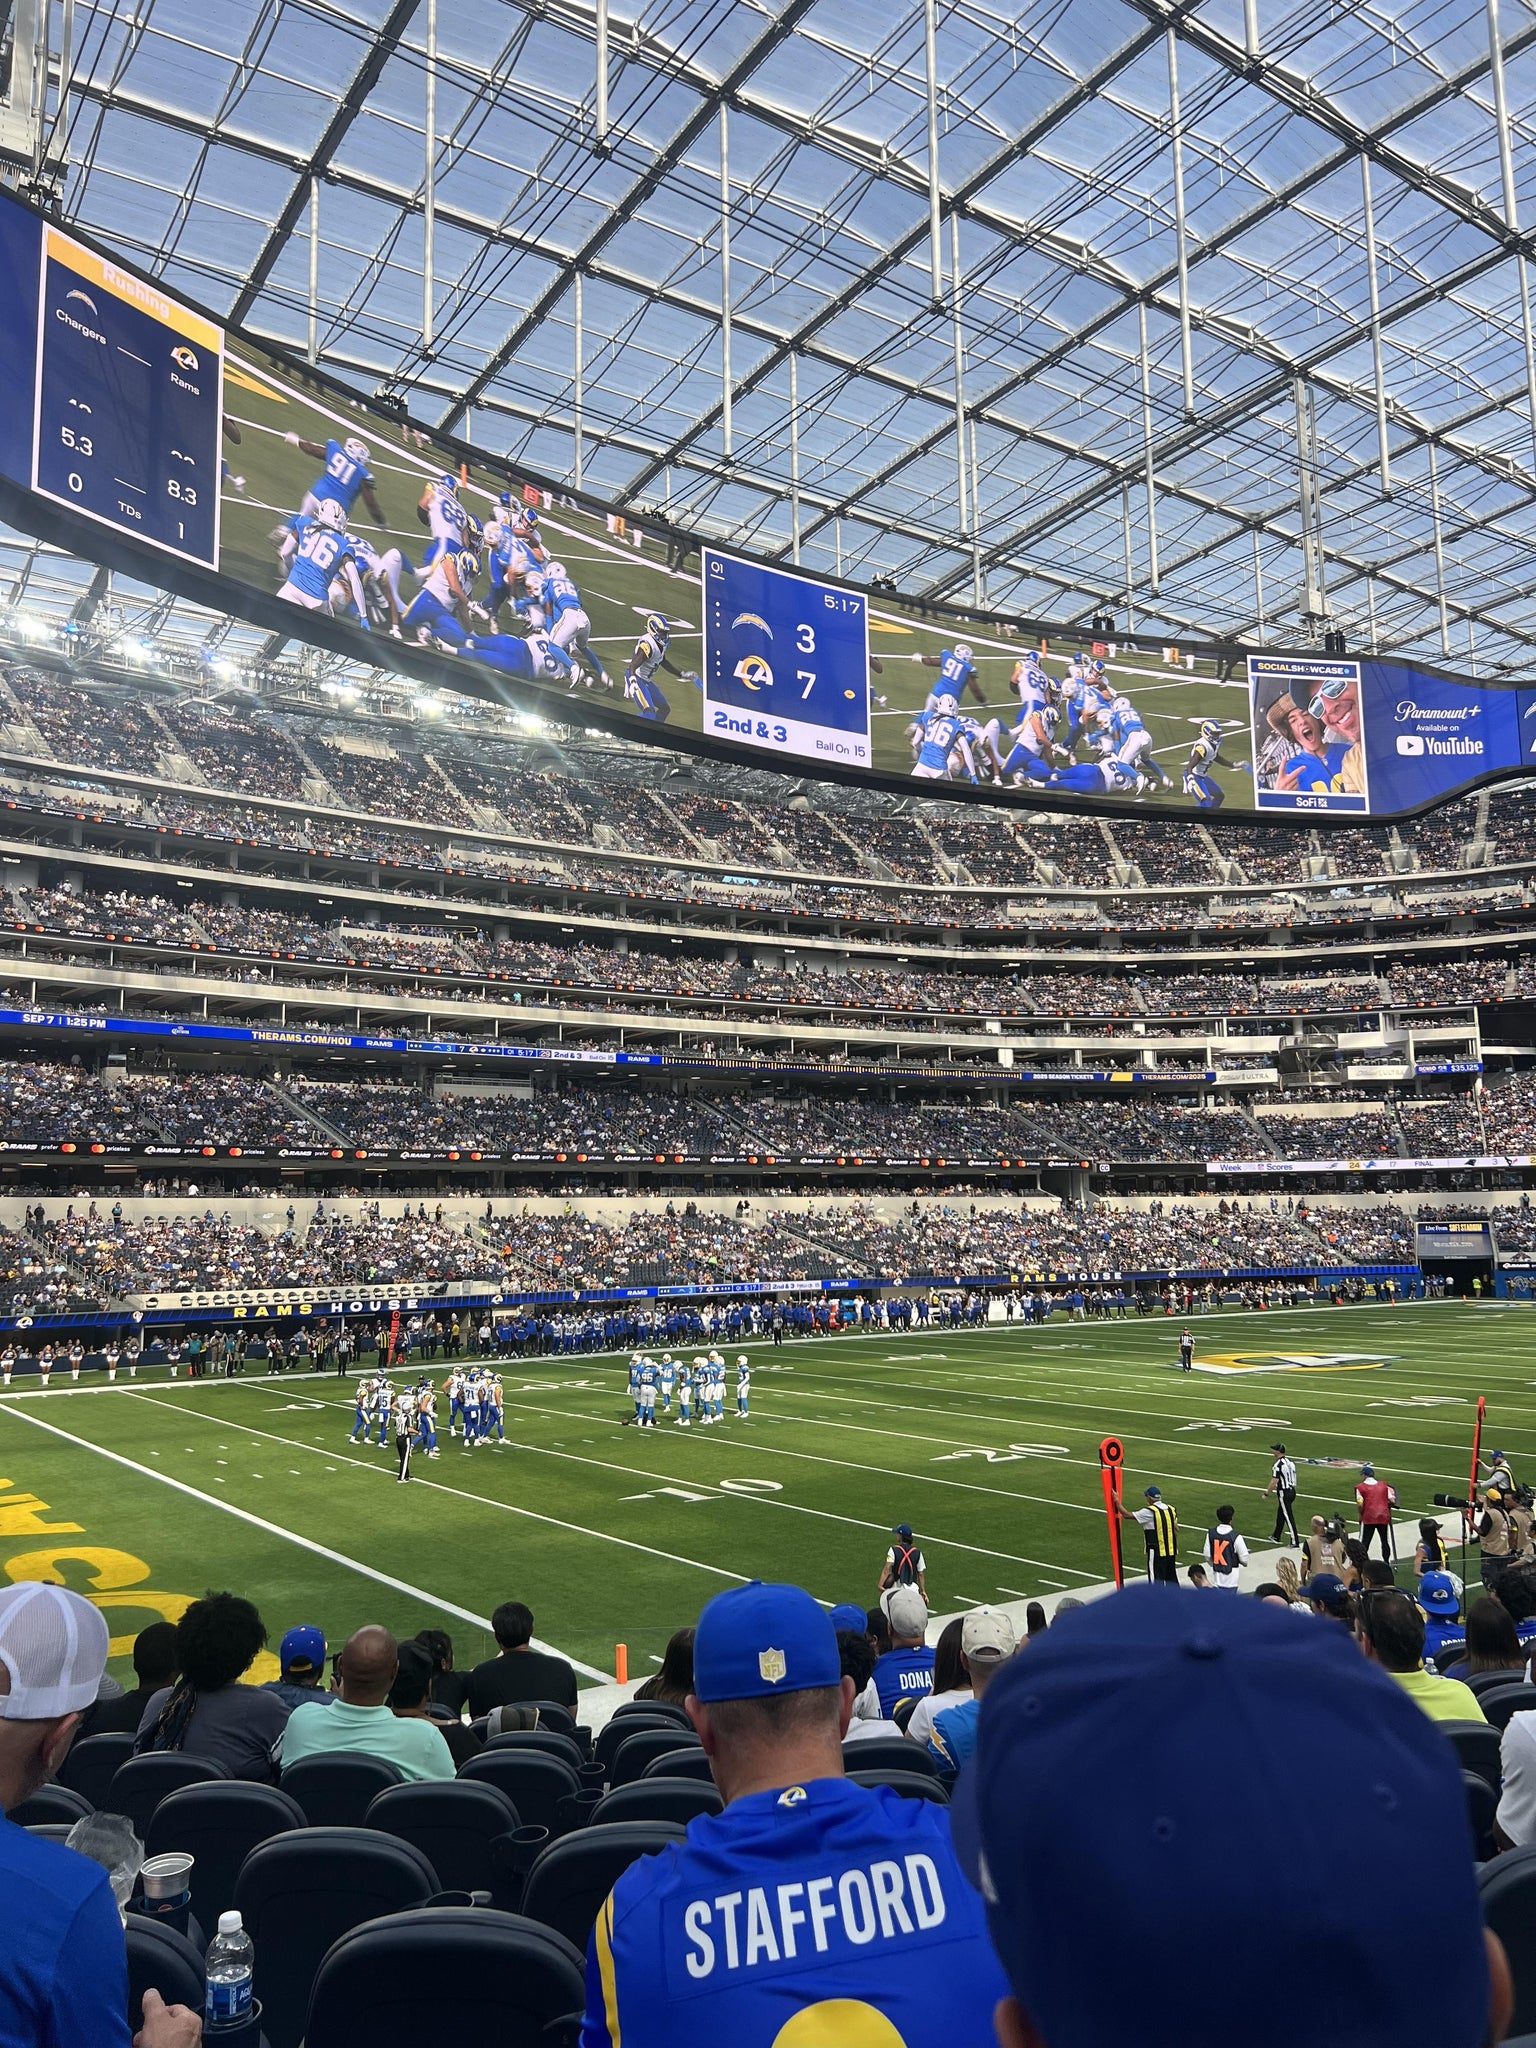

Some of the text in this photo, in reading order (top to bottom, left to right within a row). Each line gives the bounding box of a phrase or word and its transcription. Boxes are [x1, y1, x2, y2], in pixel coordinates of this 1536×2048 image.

[102, 262, 171, 320] Rushing
[56, 308, 107, 346] Chargers
[170, 372, 200, 396] Rams
[61, 425, 93, 457] 5.3
[68, 471, 83, 493] 0
[167, 479, 197, 506] 8.3
[118, 501, 142, 521] TDs
[178, 522, 184, 540] 1
[824, 594, 860, 614] 5:17
[796, 623, 816, 654] 3
[796, 670, 816, 700] 7
[1394, 700, 1482, 722] Paramount+
[714, 711, 788, 743] 2nd & 3
[1416, 724, 1448, 733] Available
[816, 740, 866, 757] Ball On 15
[1425, 736, 1483, 755] YouTube
[1296, 797, 1317, 808] SoFi
[23, 1014, 106, 1028] SEP 7 1:25 PM
[252, 1031, 352, 1046] THERAMS.COM/HOU
[366, 1040, 393, 1048] RAMS
[1266, 1163, 1293, 1171] Scores
[1492, 1158, 1498, 1166] 3
[1010, 1272, 1122, 1283] RAMS HOUSE
[234, 1298, 419, 1318] RAMS HOUSE
[1212, 1538, 1229, 1567] K
[763, 1664, 783, 1677] NFL
[684, 1853, 947, 1979] STAFFORD
